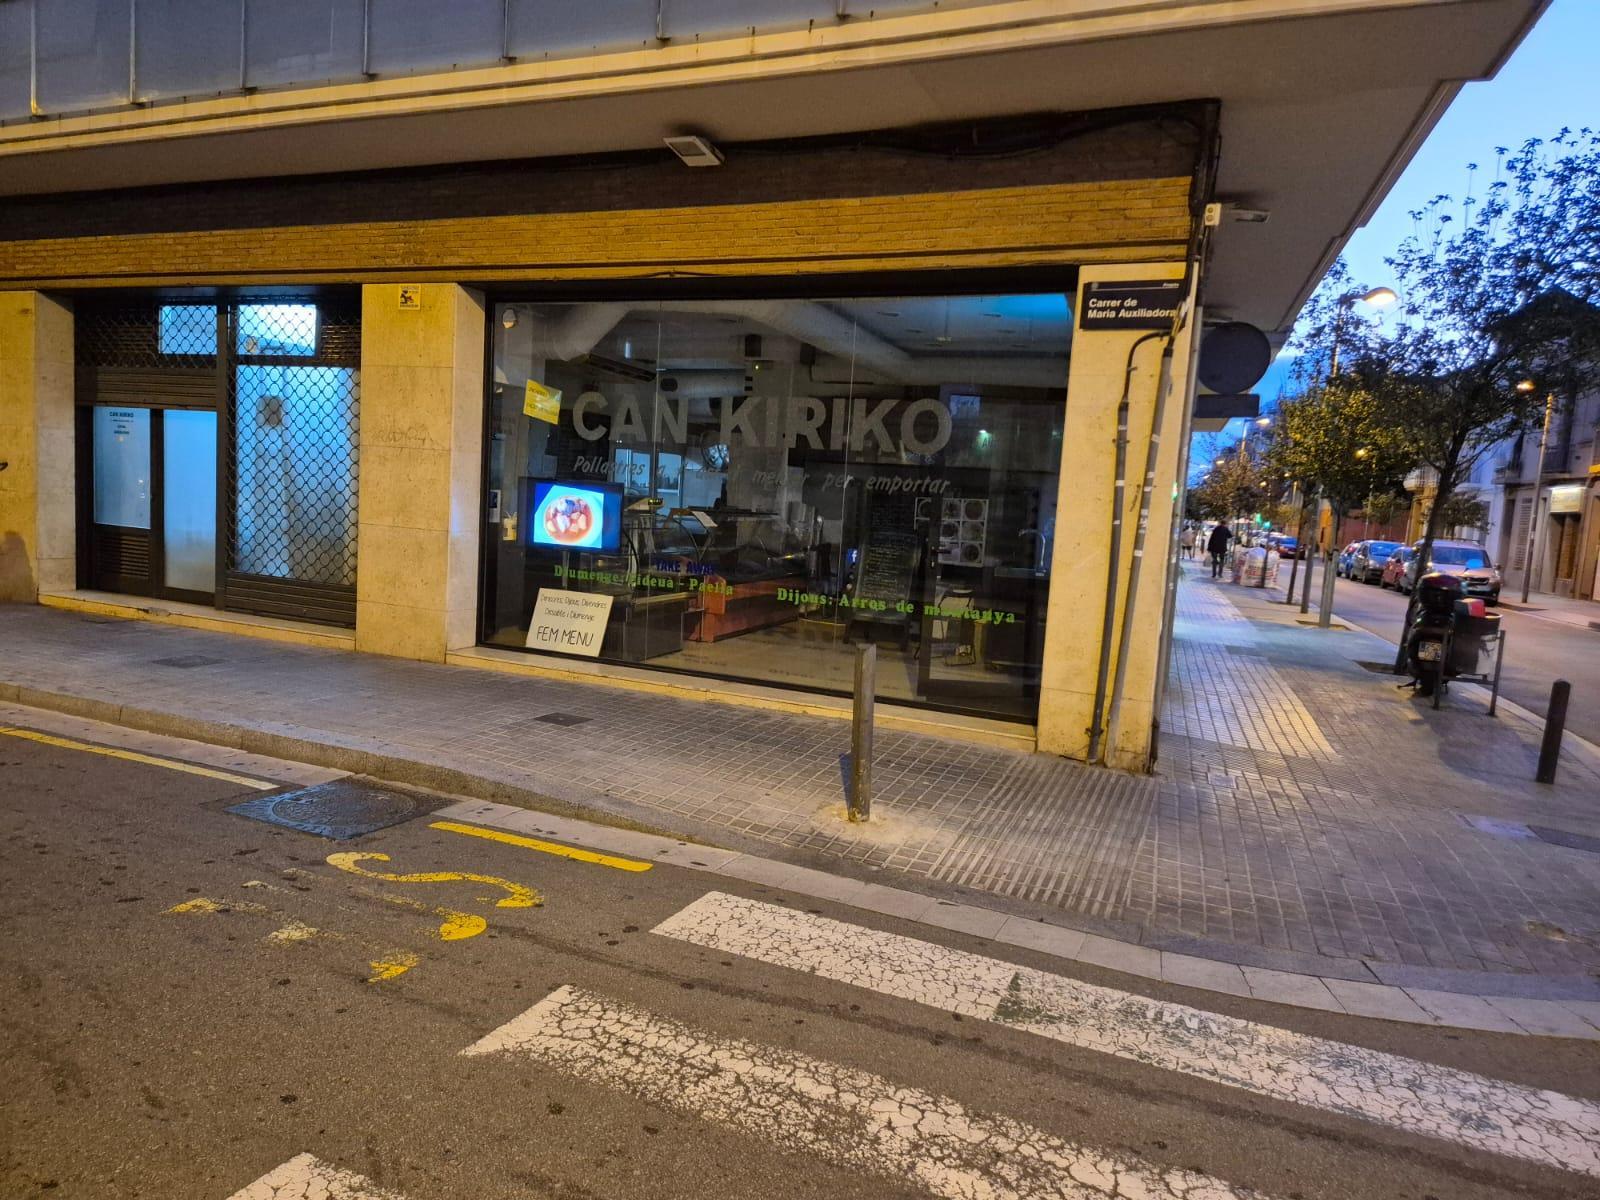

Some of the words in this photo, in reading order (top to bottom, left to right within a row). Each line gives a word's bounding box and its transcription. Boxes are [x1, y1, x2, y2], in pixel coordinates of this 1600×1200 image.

[1089, 298, 1122, 307] Carrer
[1123, 298, 1138, 307] de
[1087, 308, 1116, 319] Maria
[1118, 308, 1177, 318] Auxiliadora
[572, 391, 689, 444] CAN
[719, 396, 952, 455] KIRIKO
[573, 455, 645, 476] Pollastres
[822, 472, 854, 491] per
[866, 474, 951, 495] emportar
[689, 578, 733, 596] Paella
[777, 588, 833, 605] Dijous:
[896, 600, 914, 613] de
[537, 626, 559, 642] FEM
[561, 628, 594, 647] MENU
